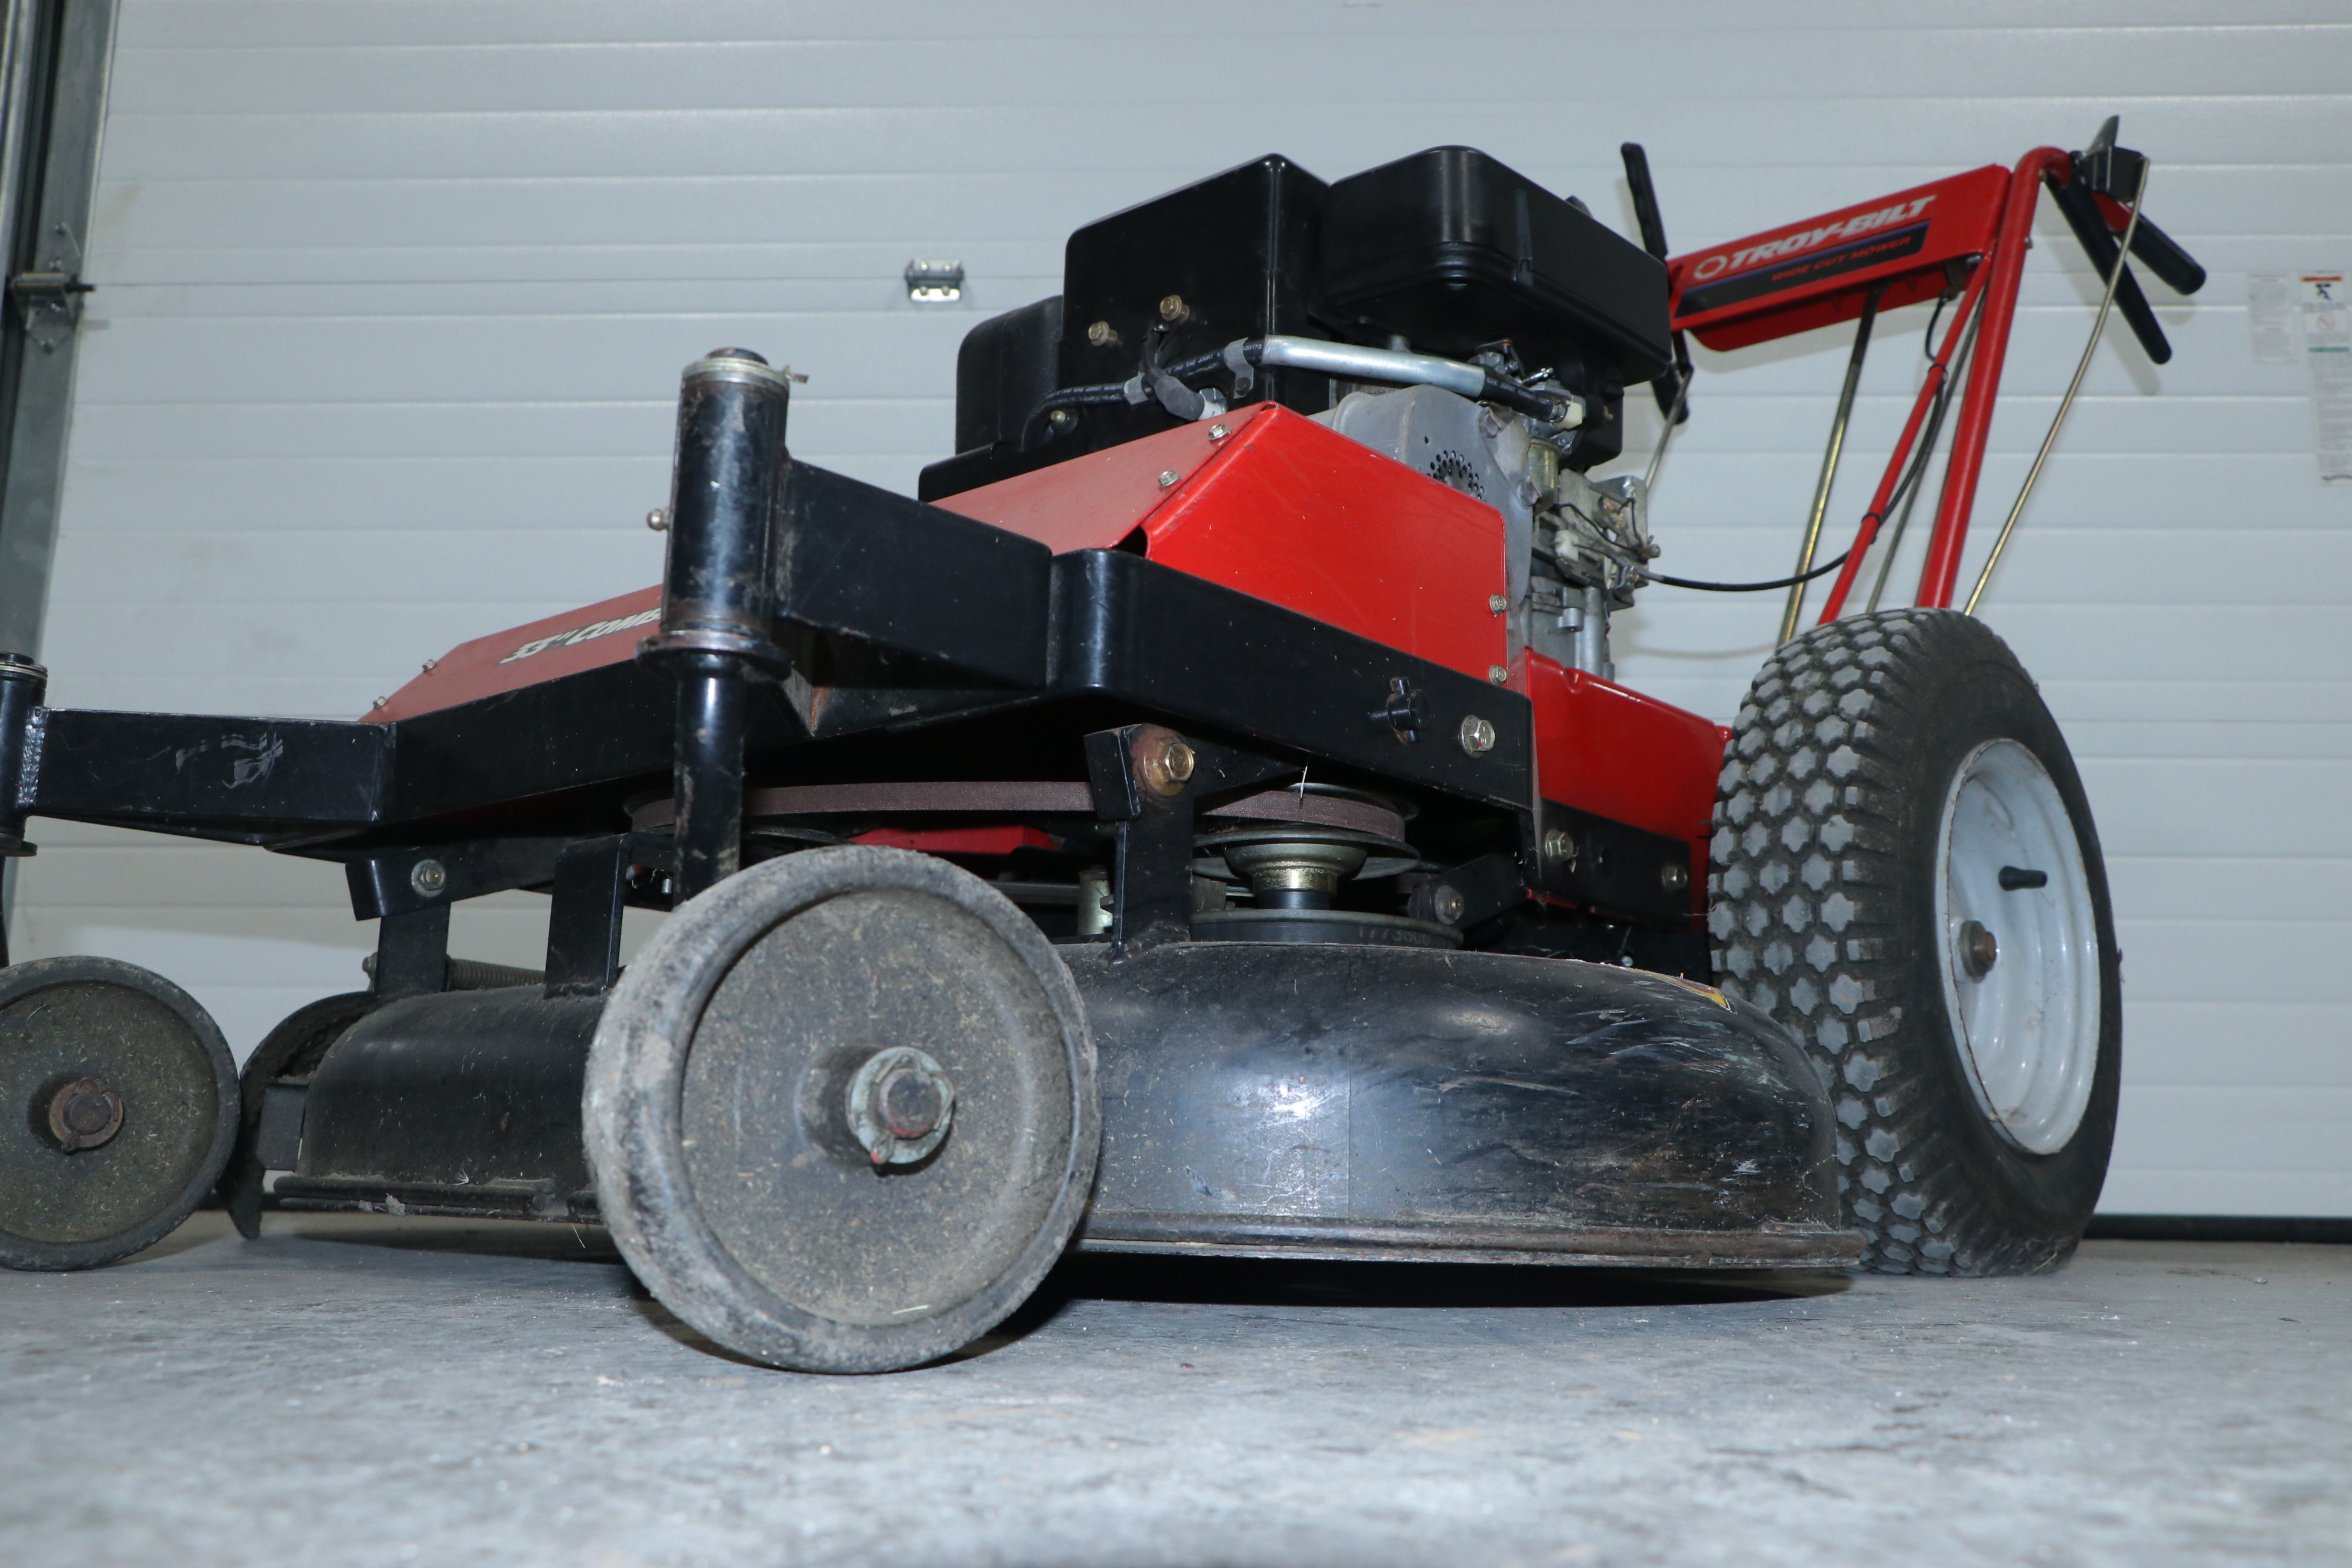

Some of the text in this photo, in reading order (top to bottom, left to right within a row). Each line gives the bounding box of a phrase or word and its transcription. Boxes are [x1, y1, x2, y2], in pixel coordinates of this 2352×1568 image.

[1730, 195, 1938, 269] TROY-BILT
[1772, 236, 1912, 281] WIDE CUT MOWER
